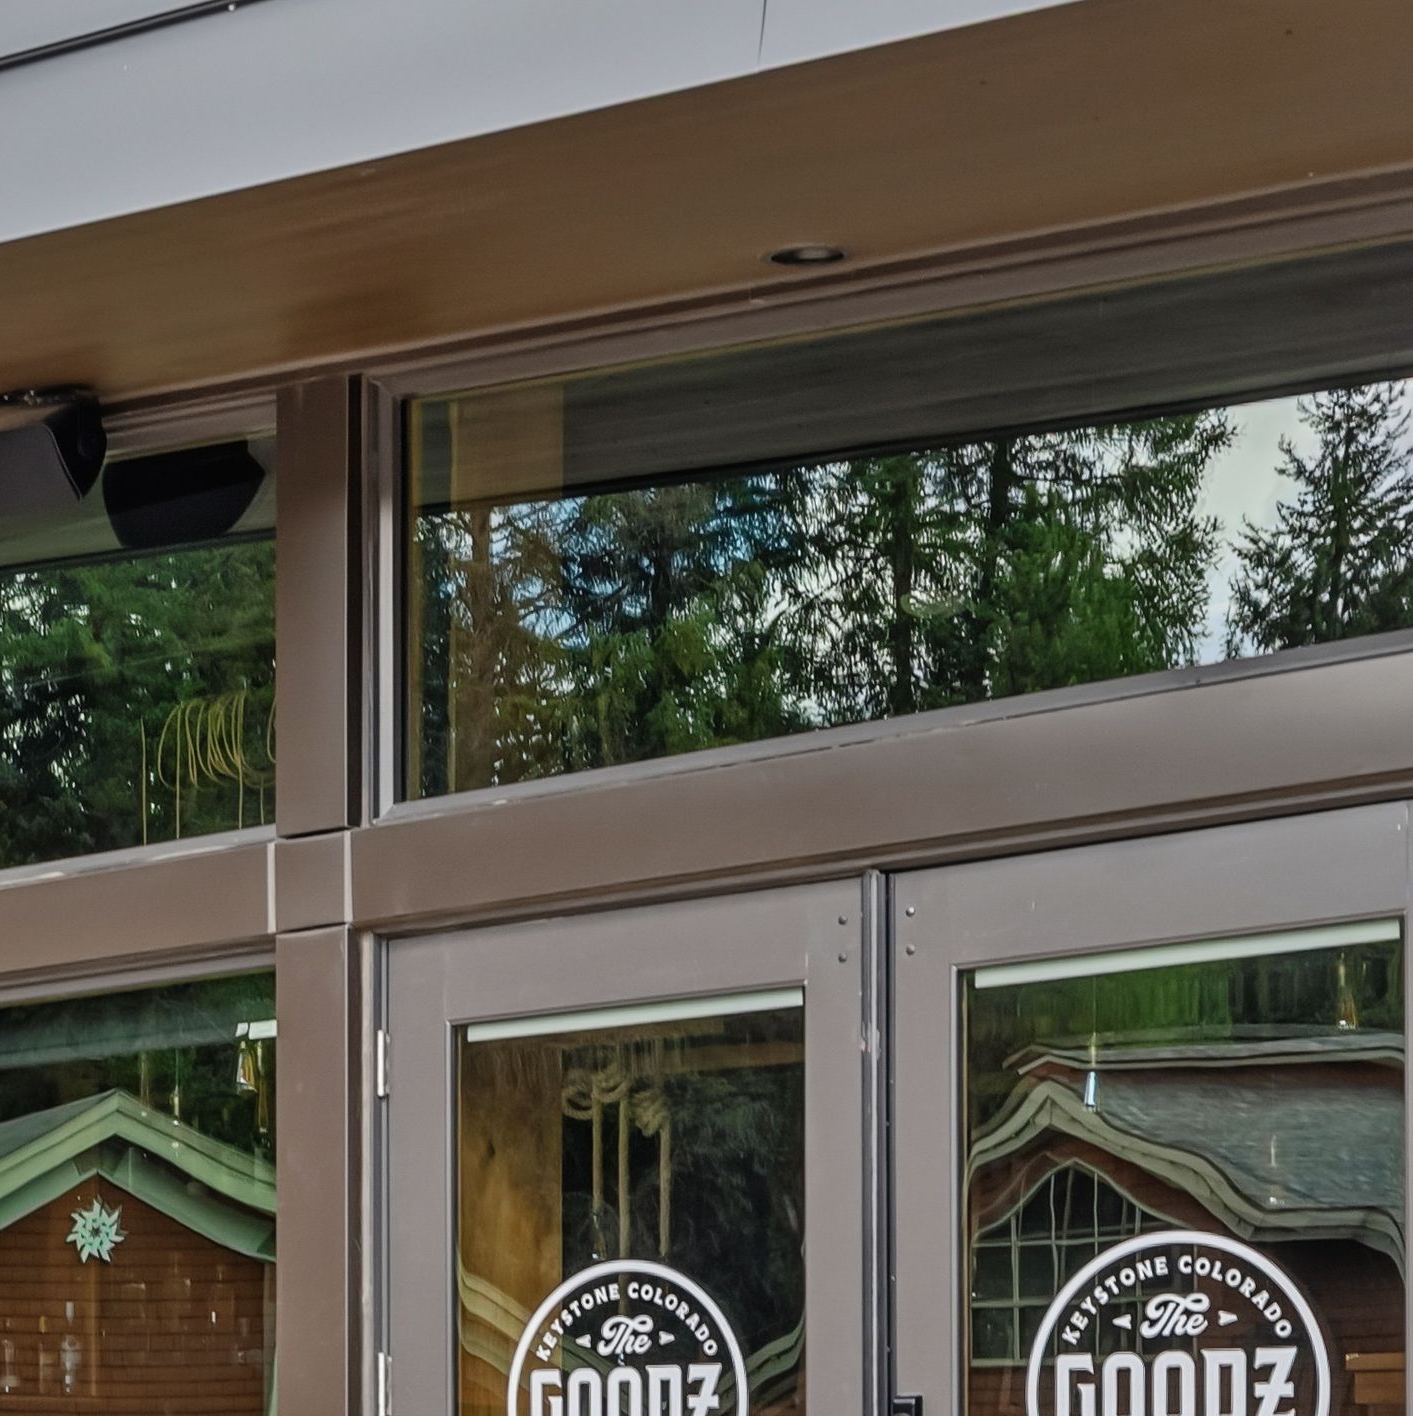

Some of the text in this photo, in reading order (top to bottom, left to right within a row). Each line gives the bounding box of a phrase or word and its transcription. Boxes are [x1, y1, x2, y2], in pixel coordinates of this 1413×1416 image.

[535, 1281, 718, 1362] KEYSTONE COLORADO
[1062, 1254, 1292, 1345] KEYSTONE COLORADO
[1140, 1291, 1210, 1339] The
[597, 1314, 654, 1356] The
